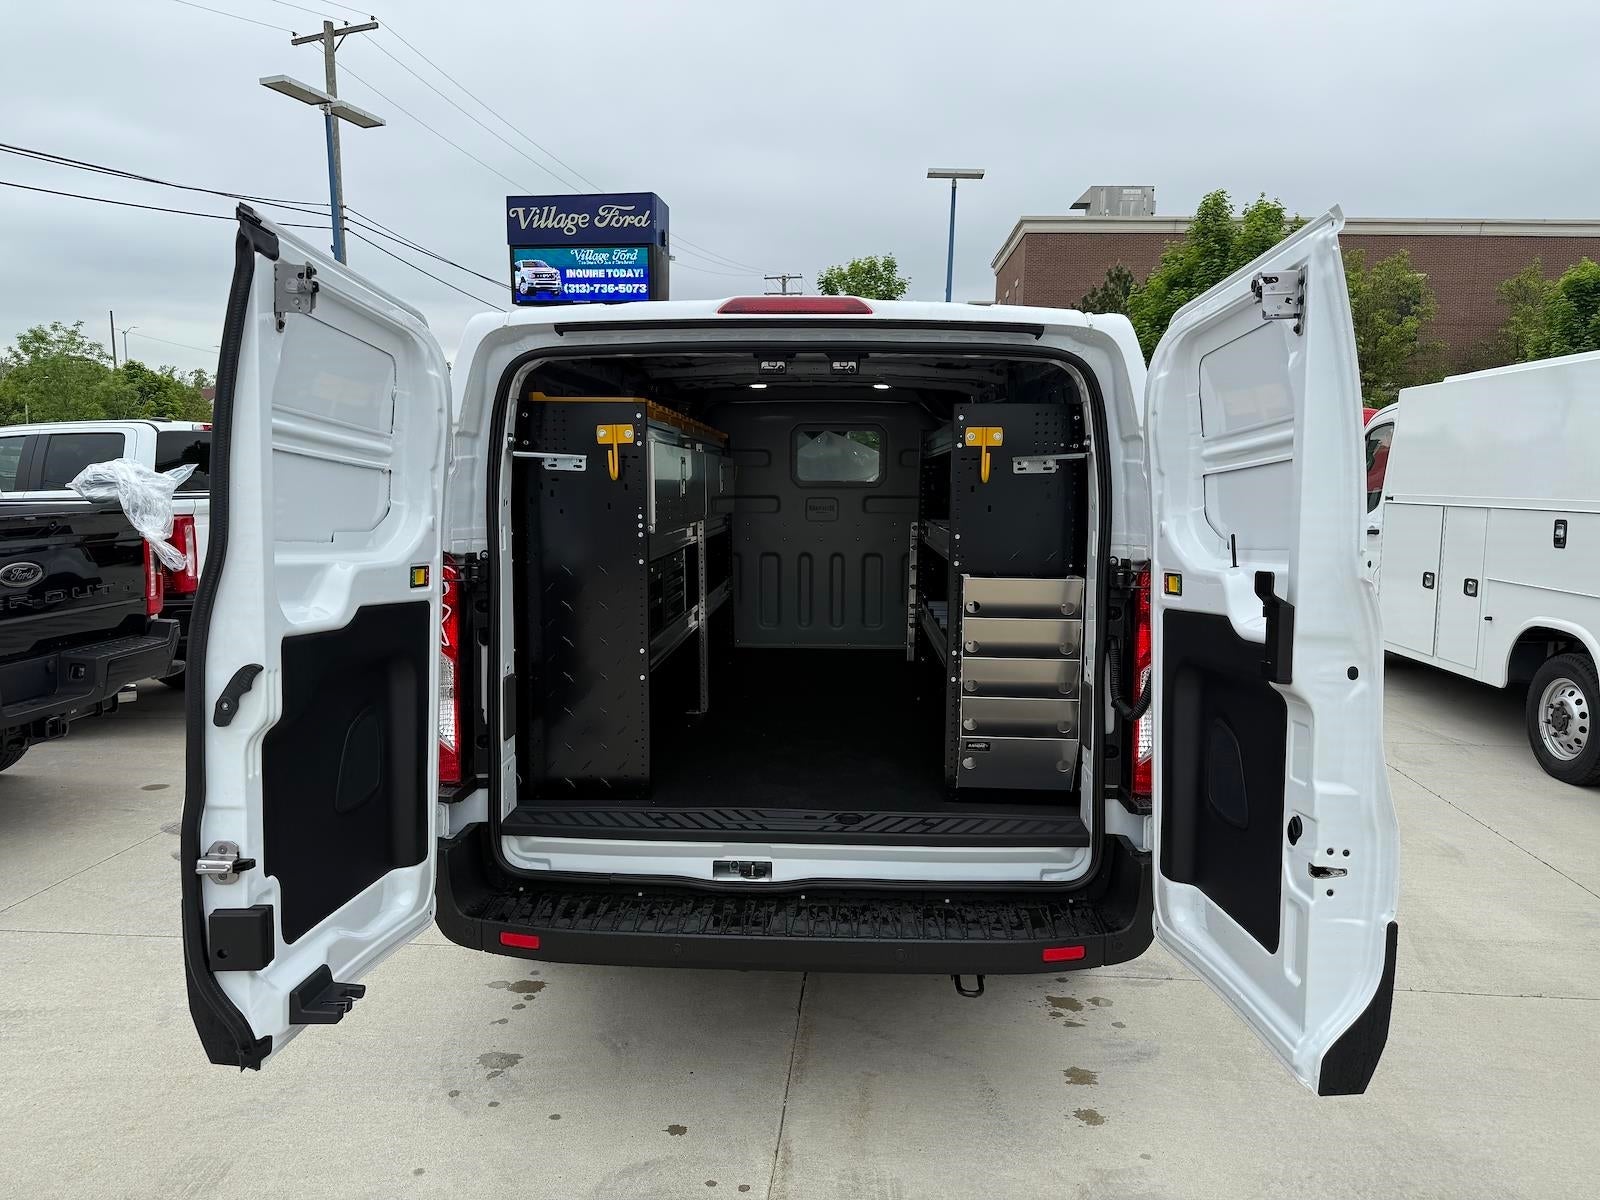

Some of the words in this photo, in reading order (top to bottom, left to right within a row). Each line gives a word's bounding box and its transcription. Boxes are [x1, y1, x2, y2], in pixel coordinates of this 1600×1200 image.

[509, 205, 590, 236] Village
[594, 204, 651, 228] Ford
[570, 249, 609, 265] Village
[612, 249, 638, 260] Ford
[566, 269, 605, 278] INQUIRE
[606, 269, 644, 278] TODAY!
[564, 283, 647, 294] (313)-736-5073
[10, 567, 35, 581] Ford
